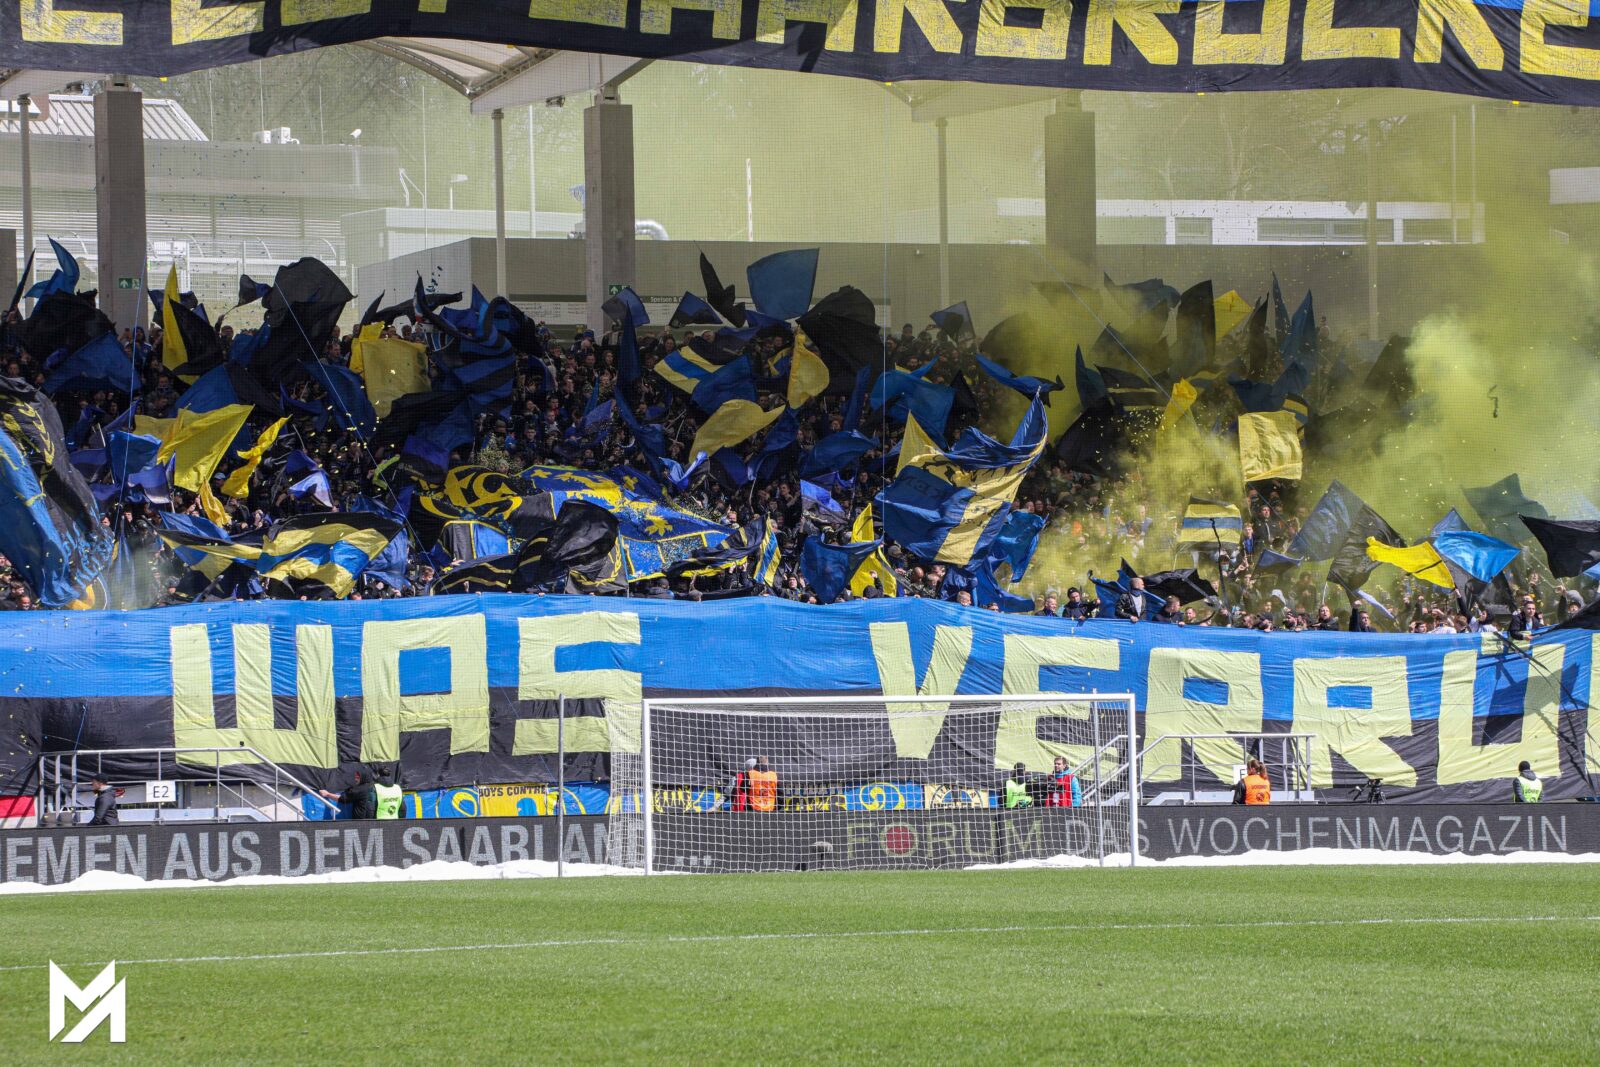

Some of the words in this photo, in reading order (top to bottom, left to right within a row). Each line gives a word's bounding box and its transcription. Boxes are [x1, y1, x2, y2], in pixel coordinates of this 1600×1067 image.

[169, 611, 643, 769] WAS
[868, 620, 1600, 788] VERRÜ
[153, 786, 169, 798] E2
[478, 787, 504, 798] BOYS
[6, 833, 148, 885] EMEN
[162, 830, 262, 881] AUS
[279, 828, 385, 877] DEM
[847, 818, 1044, 858] FORUM
[1064, 816, 1150, 855] DAS
[1167, 815, 1568, 854] WOCHENMAGAZIN
